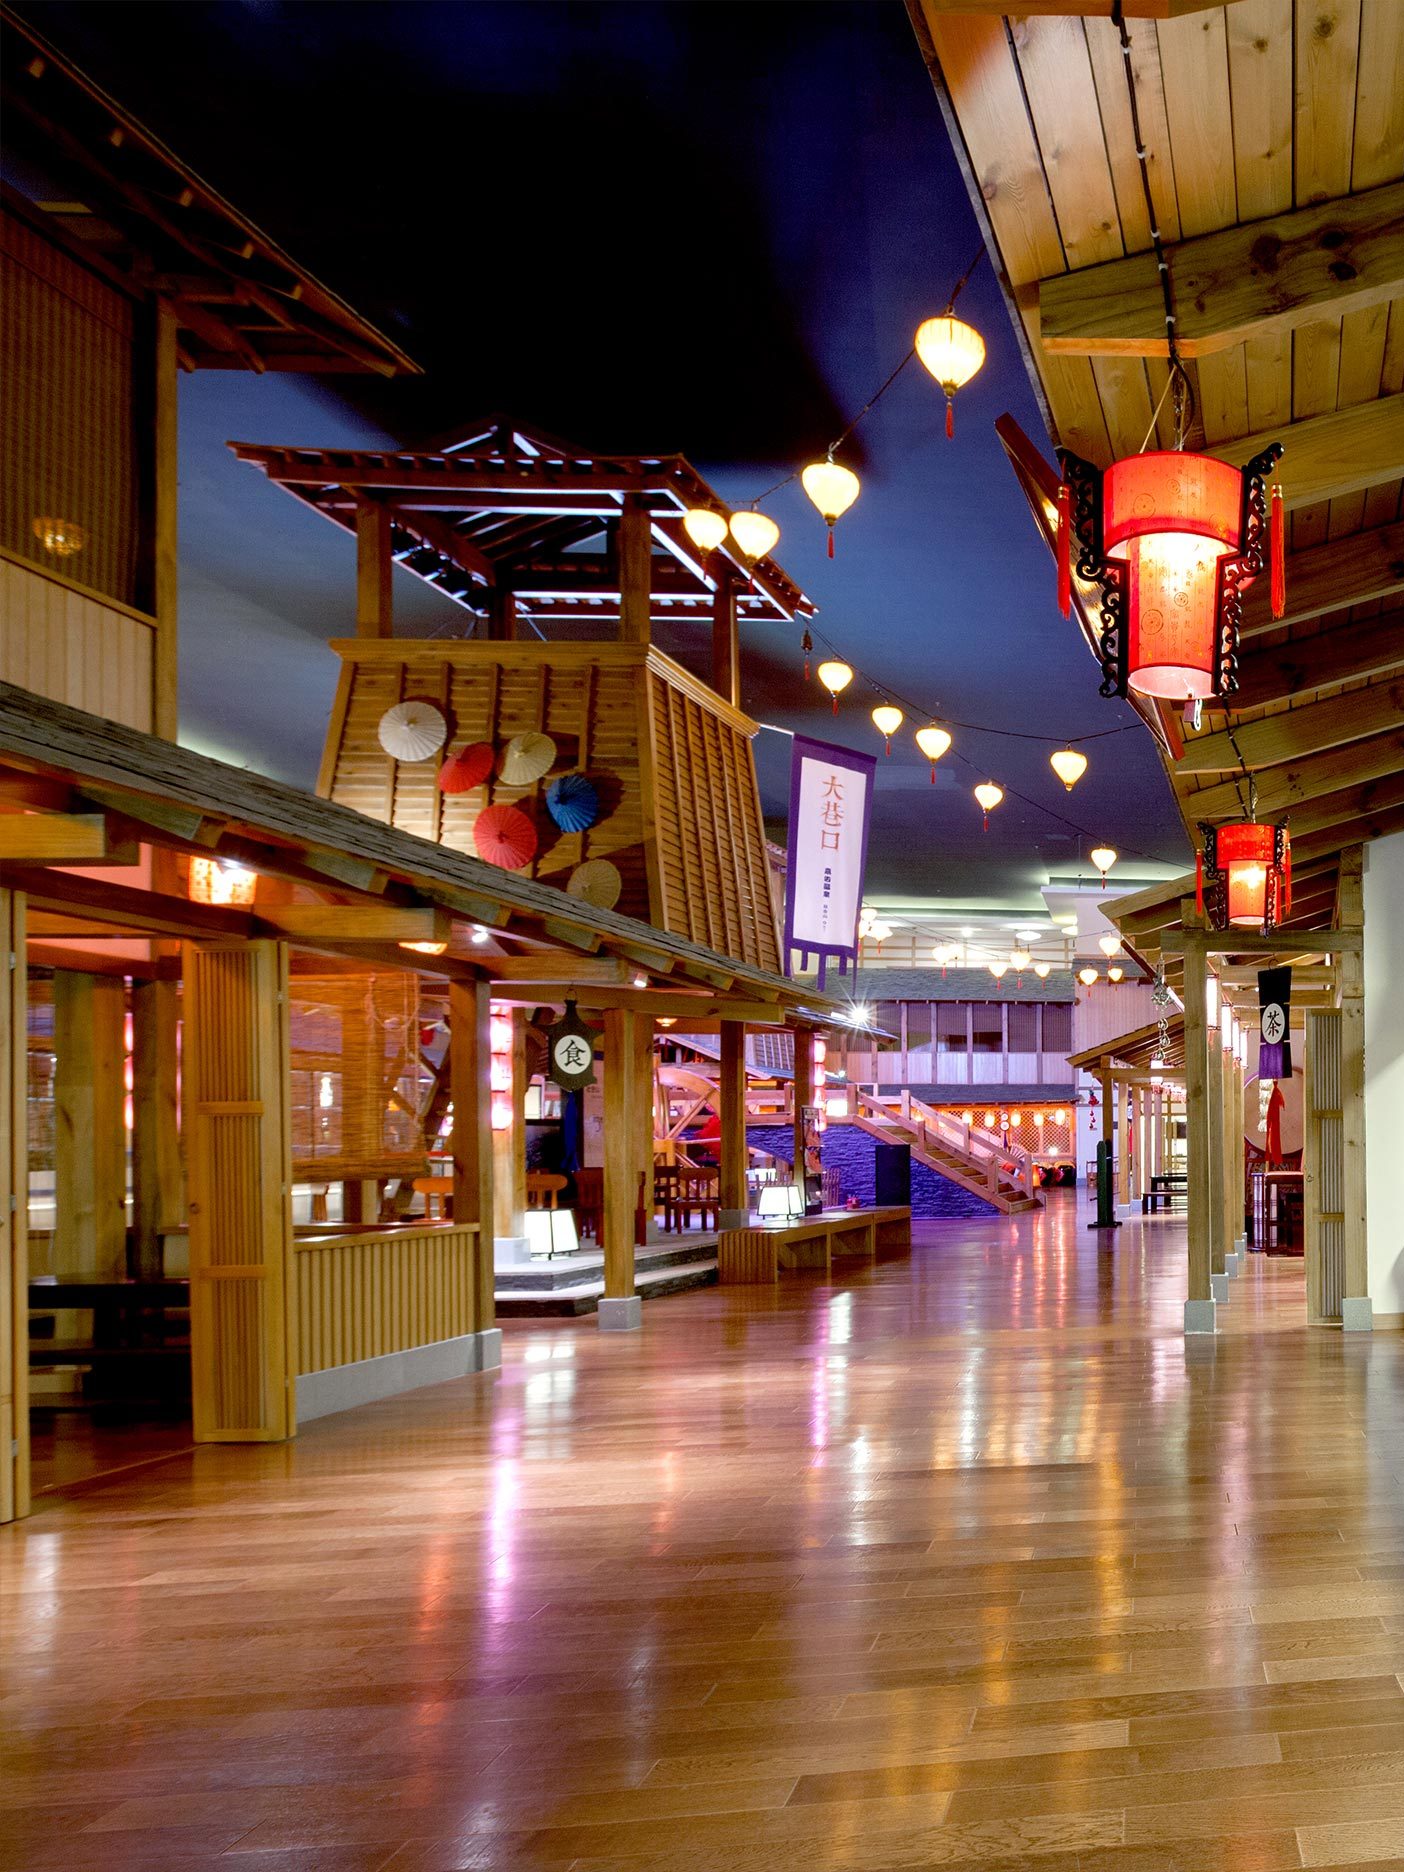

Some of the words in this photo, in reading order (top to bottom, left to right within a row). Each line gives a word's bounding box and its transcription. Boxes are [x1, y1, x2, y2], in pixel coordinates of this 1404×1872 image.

[820, 775, 845, 850] 大巷口
[1265, 1010, 1282, 1038] 茶
[559, 1039, 587, 1068] 食
